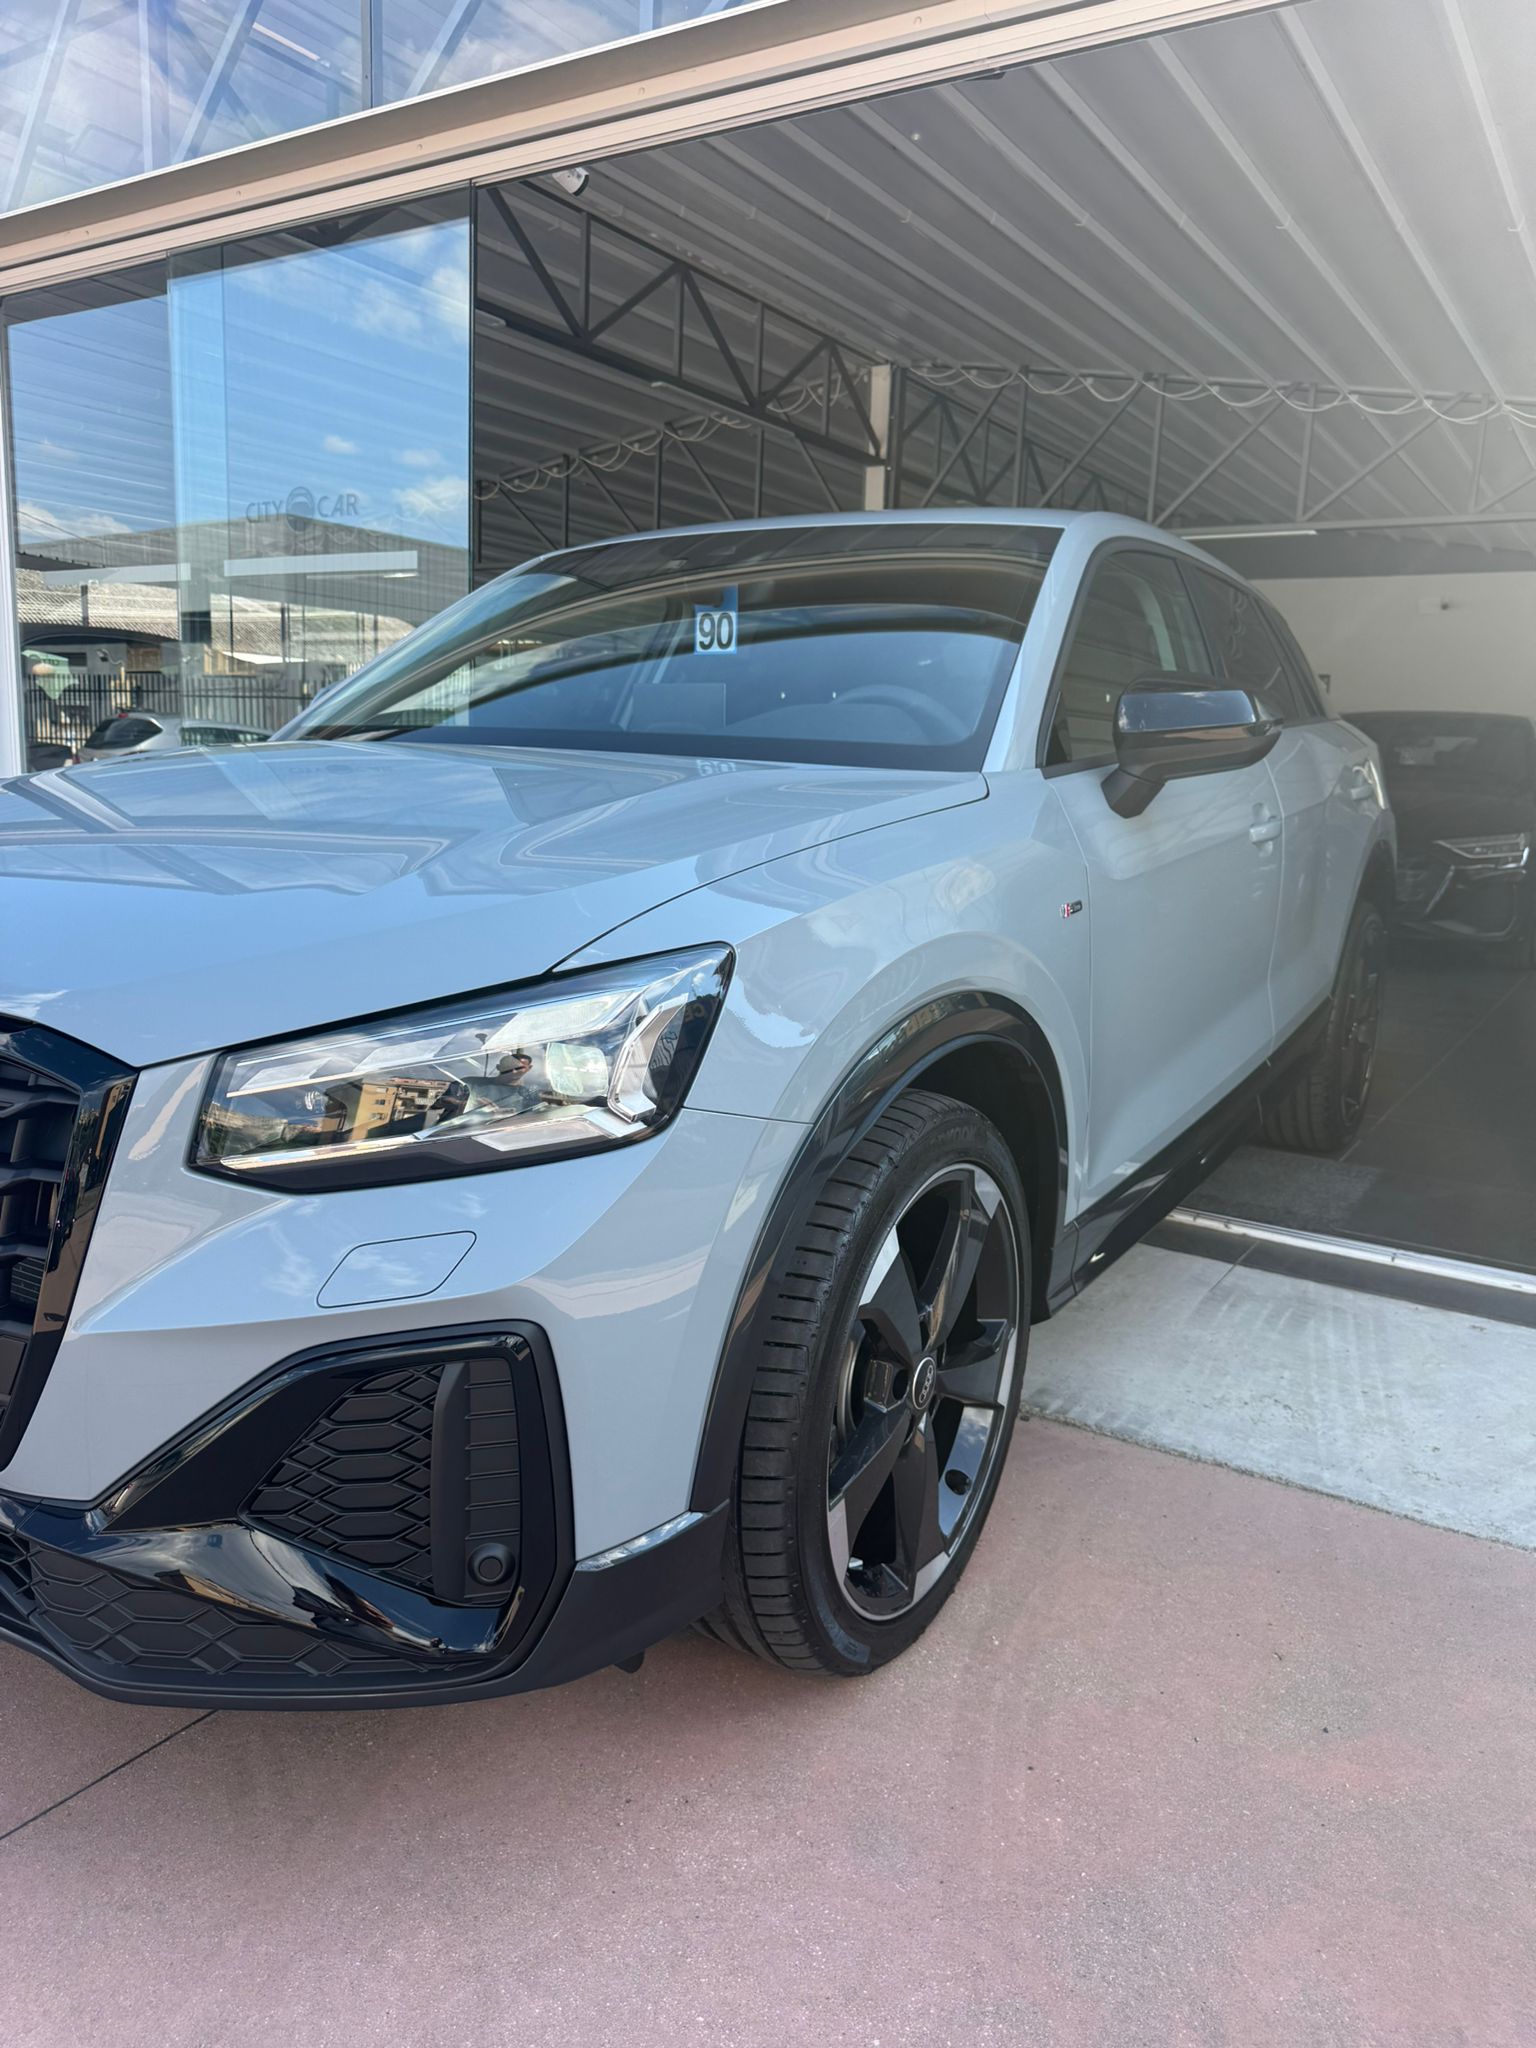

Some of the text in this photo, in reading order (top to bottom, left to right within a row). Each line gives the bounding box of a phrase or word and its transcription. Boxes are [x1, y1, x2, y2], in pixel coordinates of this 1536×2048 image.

[246, 493, 360, 524] CITY CAR
[698, 612, 734, 650] 90
